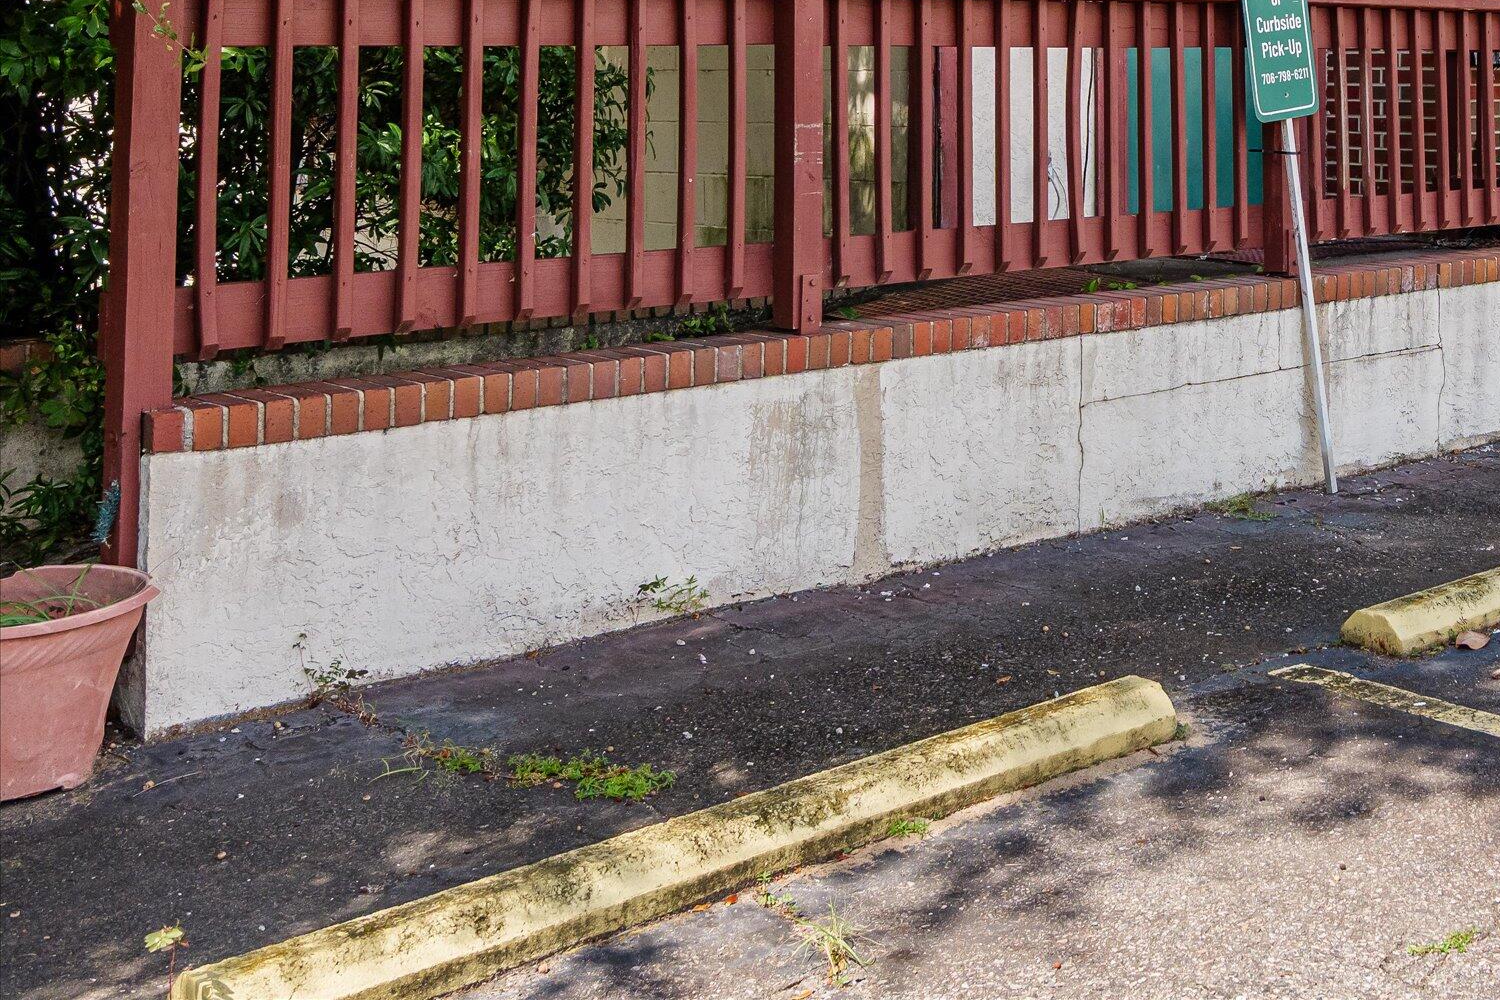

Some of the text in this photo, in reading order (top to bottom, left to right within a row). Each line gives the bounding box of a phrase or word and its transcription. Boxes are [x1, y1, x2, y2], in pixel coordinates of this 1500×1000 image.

[1256, 13, 1302, 33] Curbside
[1261, 39, 1302, 59] Pick-Up
[1261, 67, 1309, 85] 706-798-6211
